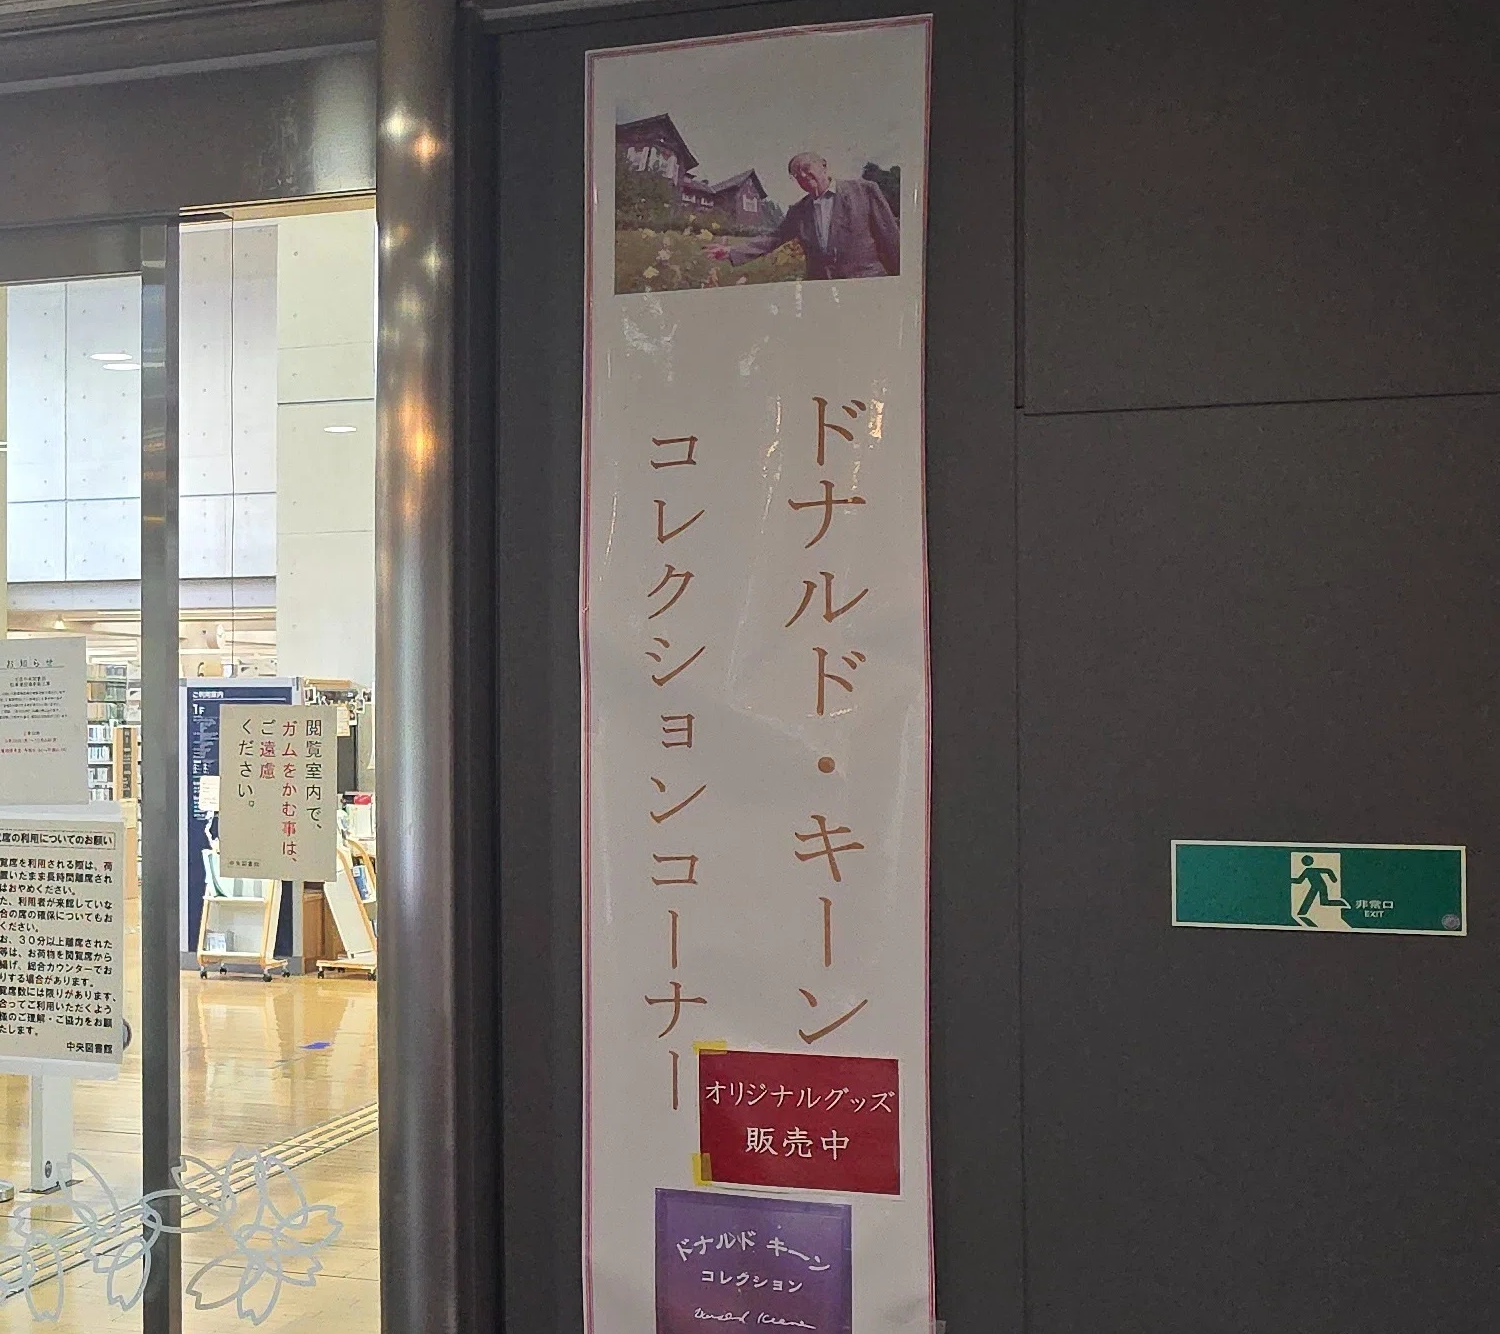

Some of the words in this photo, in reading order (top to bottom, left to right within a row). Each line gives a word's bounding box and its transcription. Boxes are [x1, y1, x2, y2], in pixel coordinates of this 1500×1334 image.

[785, 396, 869, 1045] ドナルド・キーン
[238, 718, 255, 808] ください。
[259, 719, 276, 780] ご遠慮
[281, 720, 298, 863] ガムをかむ事は、
[305, 719, 323, 830] 閲覧室内で、
[644, 435, 707, 1110] コレクションコーナー
[1355, 899, 1394, 909] 非常口
[1364, 910, 1385, 918] EXIT
[66, 1041, 113, 1055] 中央図書館
[705, 1080, 895, 1113] オリジナルグッズ
[745, 1126, 850, 1161] 販売中
[676, 1230, 757, 1262] ドナルド
[766, 1237, 831, 1271] キーン
[701, 1269, 803, 1293] コレクション
